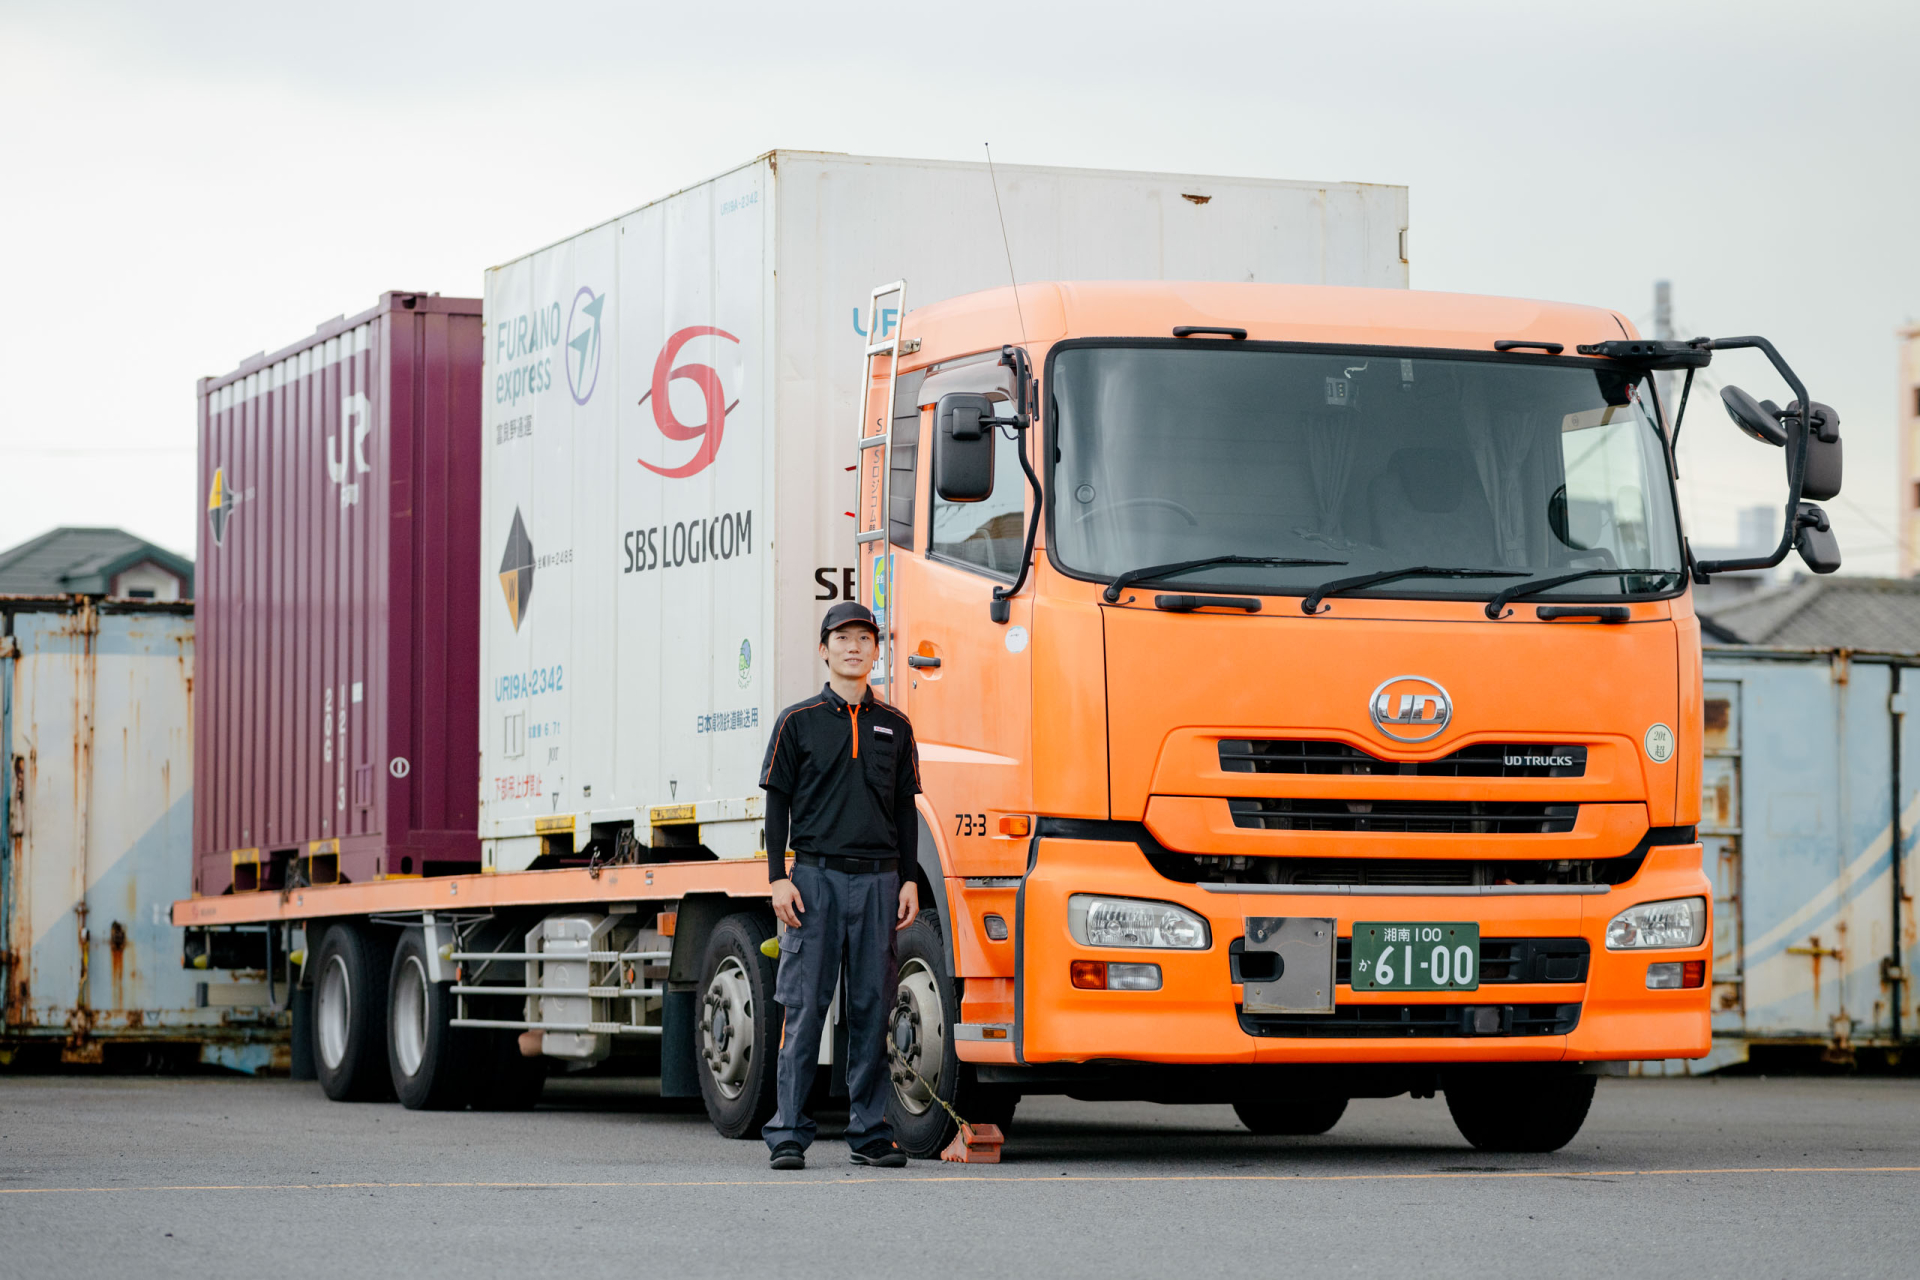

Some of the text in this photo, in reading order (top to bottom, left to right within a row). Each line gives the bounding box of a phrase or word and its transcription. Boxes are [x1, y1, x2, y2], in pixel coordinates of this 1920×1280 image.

[497, 302, 561, 365] FURANO
[496, 357, 551, 407] express
[327, 391, 371, 484] JR
[624, 509, 752, 574] SBS LOGICOM
[697, 707, 759, 734] 日本貨物鉄道輸送用
[1377, 694, 1448, 724] UD
[1653, 731, 1667, 741] 20t
[1504, 756, 1573, 766] UD TRUCKS
[1655, 745, 1665, 757] 超
[955, 814, 987, 836] 73-3
[1383, 927, 1442, 942] 湘南 100
[1358, 945, 1474, 985] か 61-00
